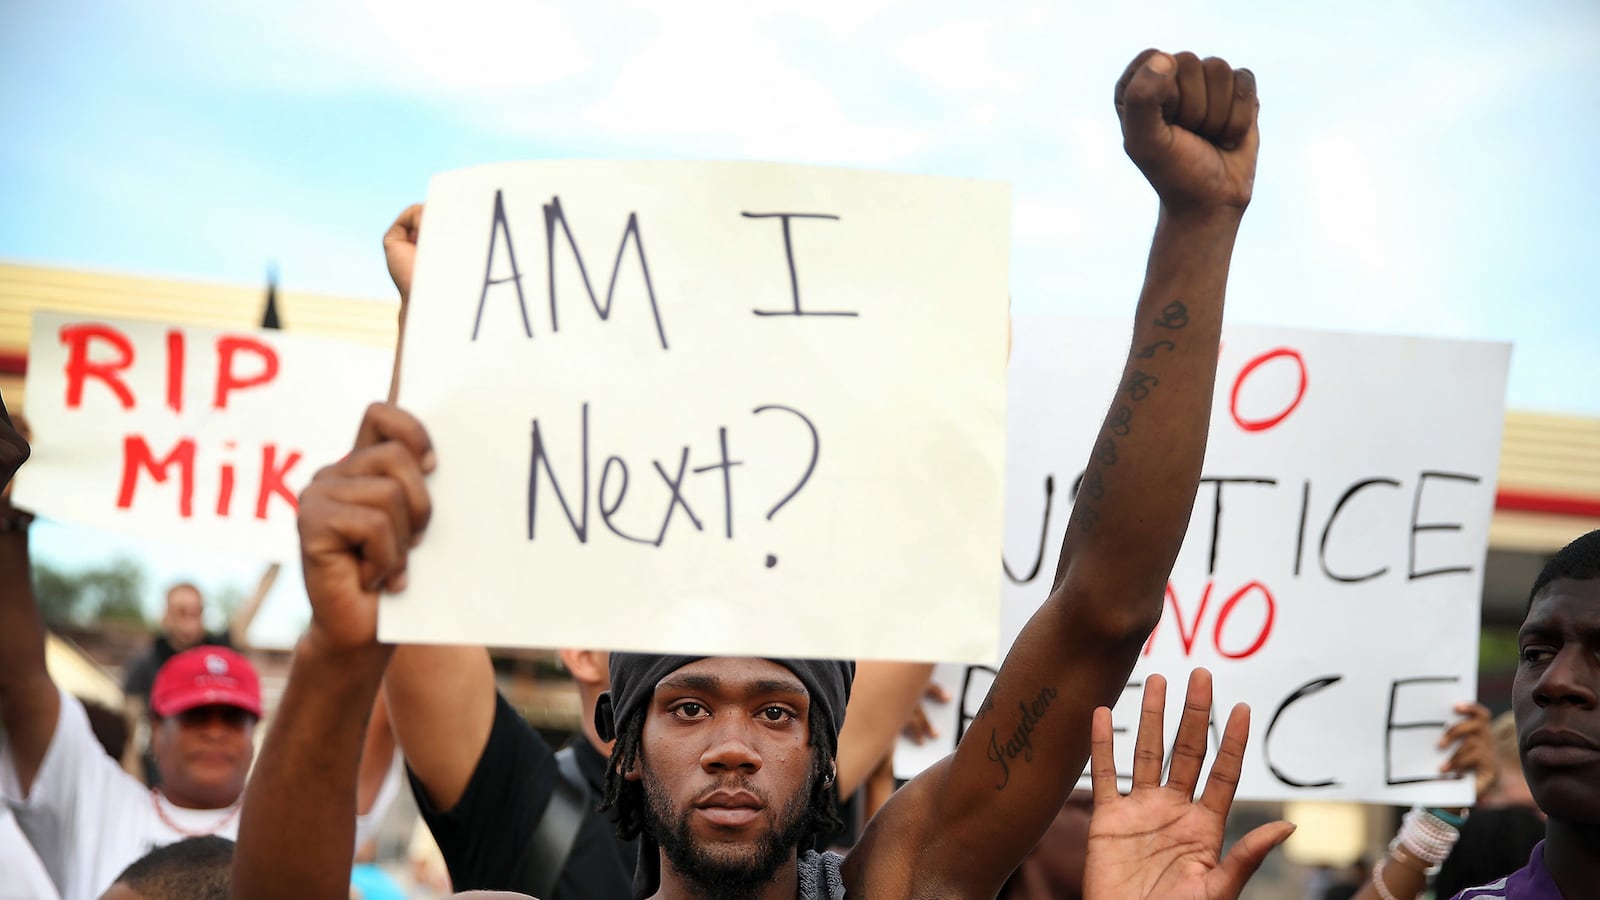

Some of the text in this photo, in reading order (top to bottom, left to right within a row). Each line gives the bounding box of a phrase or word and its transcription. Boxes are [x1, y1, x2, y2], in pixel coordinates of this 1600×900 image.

[471, 188, 860, 351] AM I
[59, 322, 281, 413] RIP
[1217, 341, 1309, 433] O
[116, 433, 351, 520] MiK
[526, 402, 821, 569] Next?
[1001, 470, 1482, 584] UTICE
[1143, 579, 1277, 661] NO
[954, 664, 1463, 787] PCE
